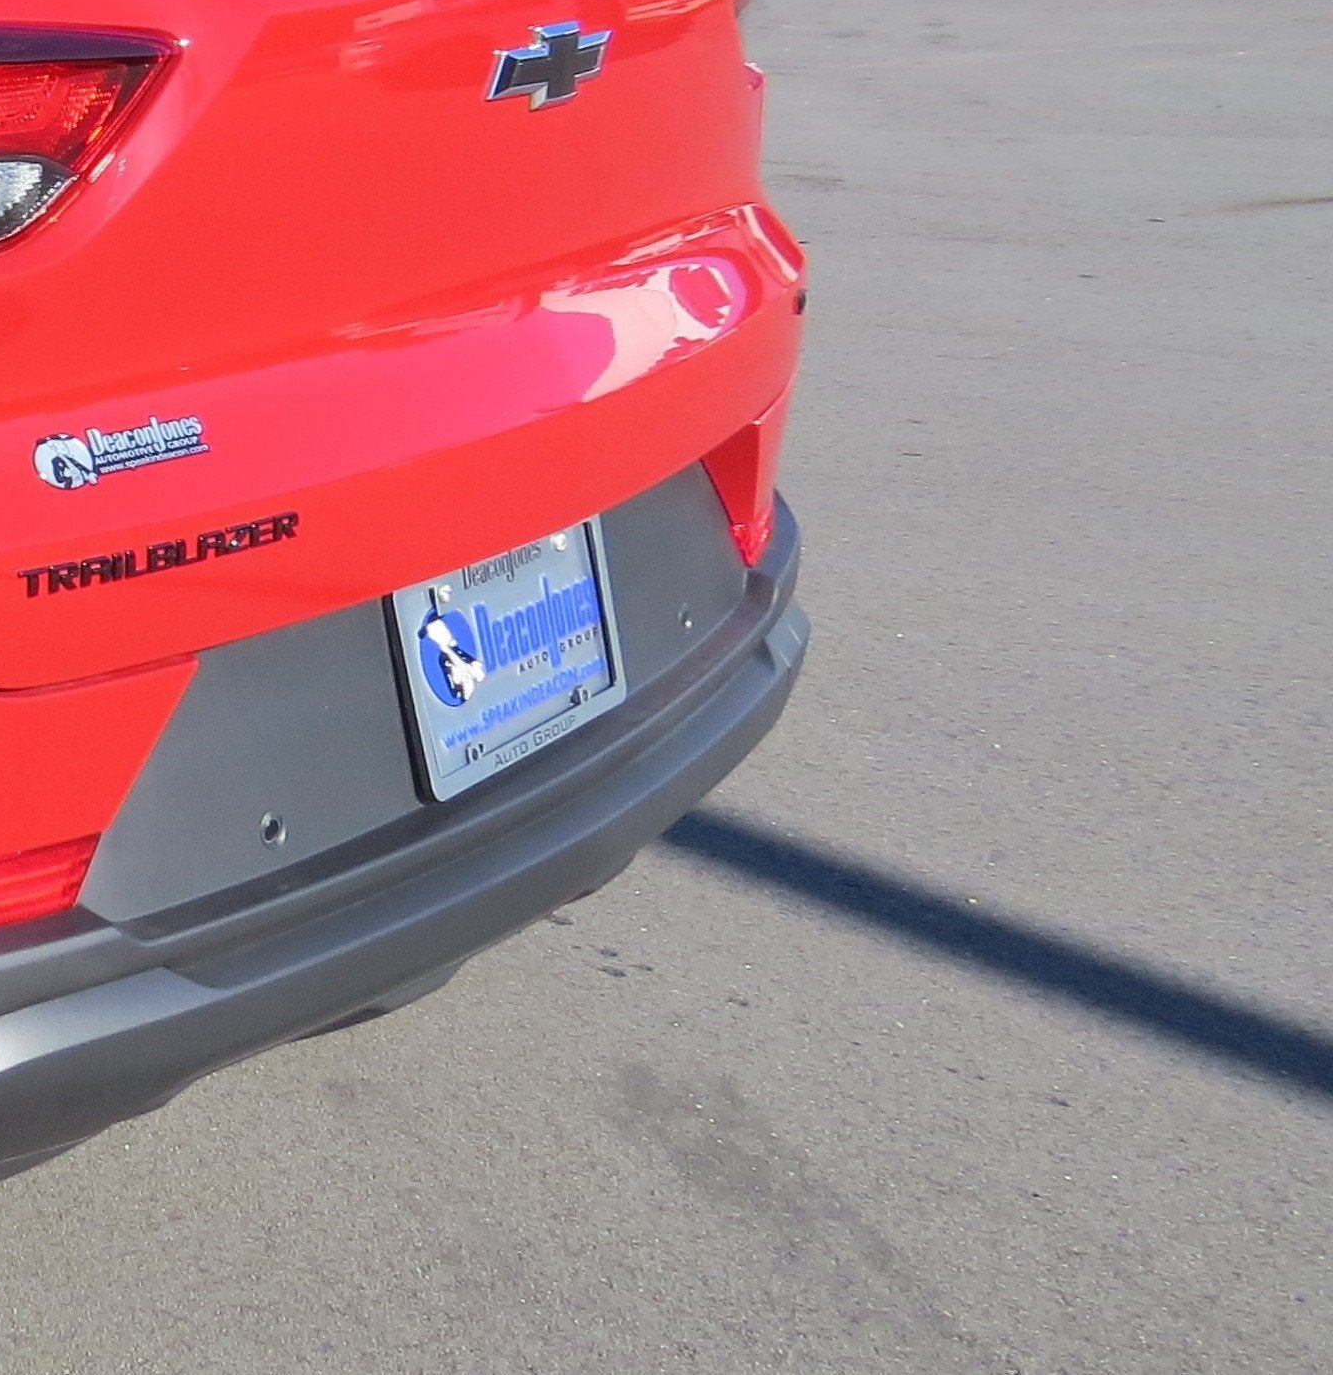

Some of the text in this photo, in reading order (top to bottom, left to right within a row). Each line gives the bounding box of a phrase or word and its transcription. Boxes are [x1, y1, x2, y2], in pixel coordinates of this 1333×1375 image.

[95, 436, 199, 466] AUTOMOTIVE GROUP
[17, 511, 299, 598] TRAILBLAZER
[518, 629, 600, 675] AUTO GROUP
[494, 715, 577, 768] AUTO GROUP
